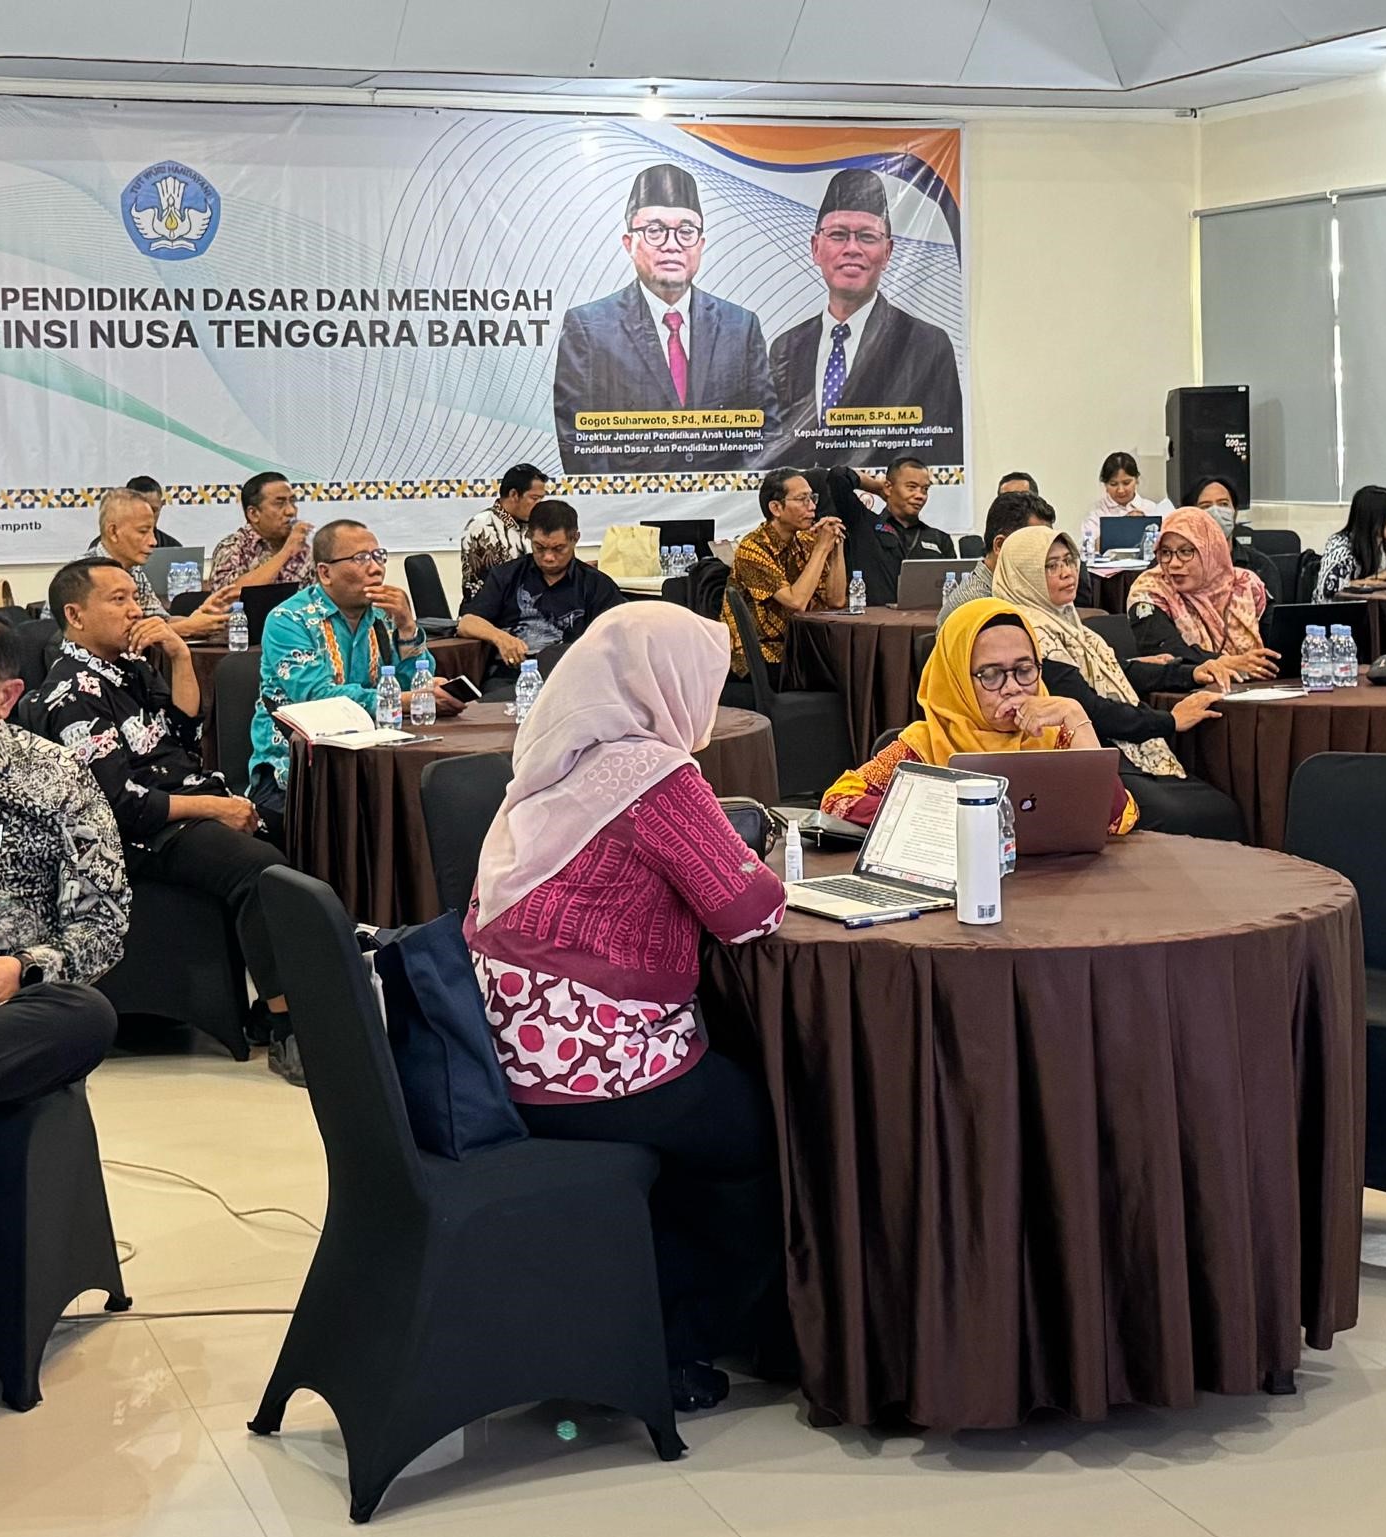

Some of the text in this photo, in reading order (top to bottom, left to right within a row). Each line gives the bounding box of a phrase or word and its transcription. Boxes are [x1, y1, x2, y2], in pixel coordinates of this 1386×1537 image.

[0, 287, 195, 312] PENDIDIKAN
[203, 288, 308, 312] DASAR
[316, 288, 380, 312] DAN
[388, 288, 553, 312] MENENGAH
[90, 319, 199, 349] NUSA
[209, 319, 419, 349] TENGGARA
[428, 319, 550, 348] BARAT
[579, 414, 760, 427] Gogot Suharwoto, S.Pd., M.Ed., Ph.D.
[830, 411, 919, 422] Katman, S.Pd., M.A.
[576, 430, 764, 441] Direktur Jenderal Pendidikan Anak Usia Dini,
[794, 428, 823, 438] Kepala
[824, 428, 844, 436] Balai
[887, 427, 908, 435] Mutu
[909, 426, 954, 435] Pendidikan
[574, 443, 764, 455] Pendidikan Dasar, dan Pendidikan Menengah
[815, 439, 933, 449] Provinsi Nusa Tenggara Barat
